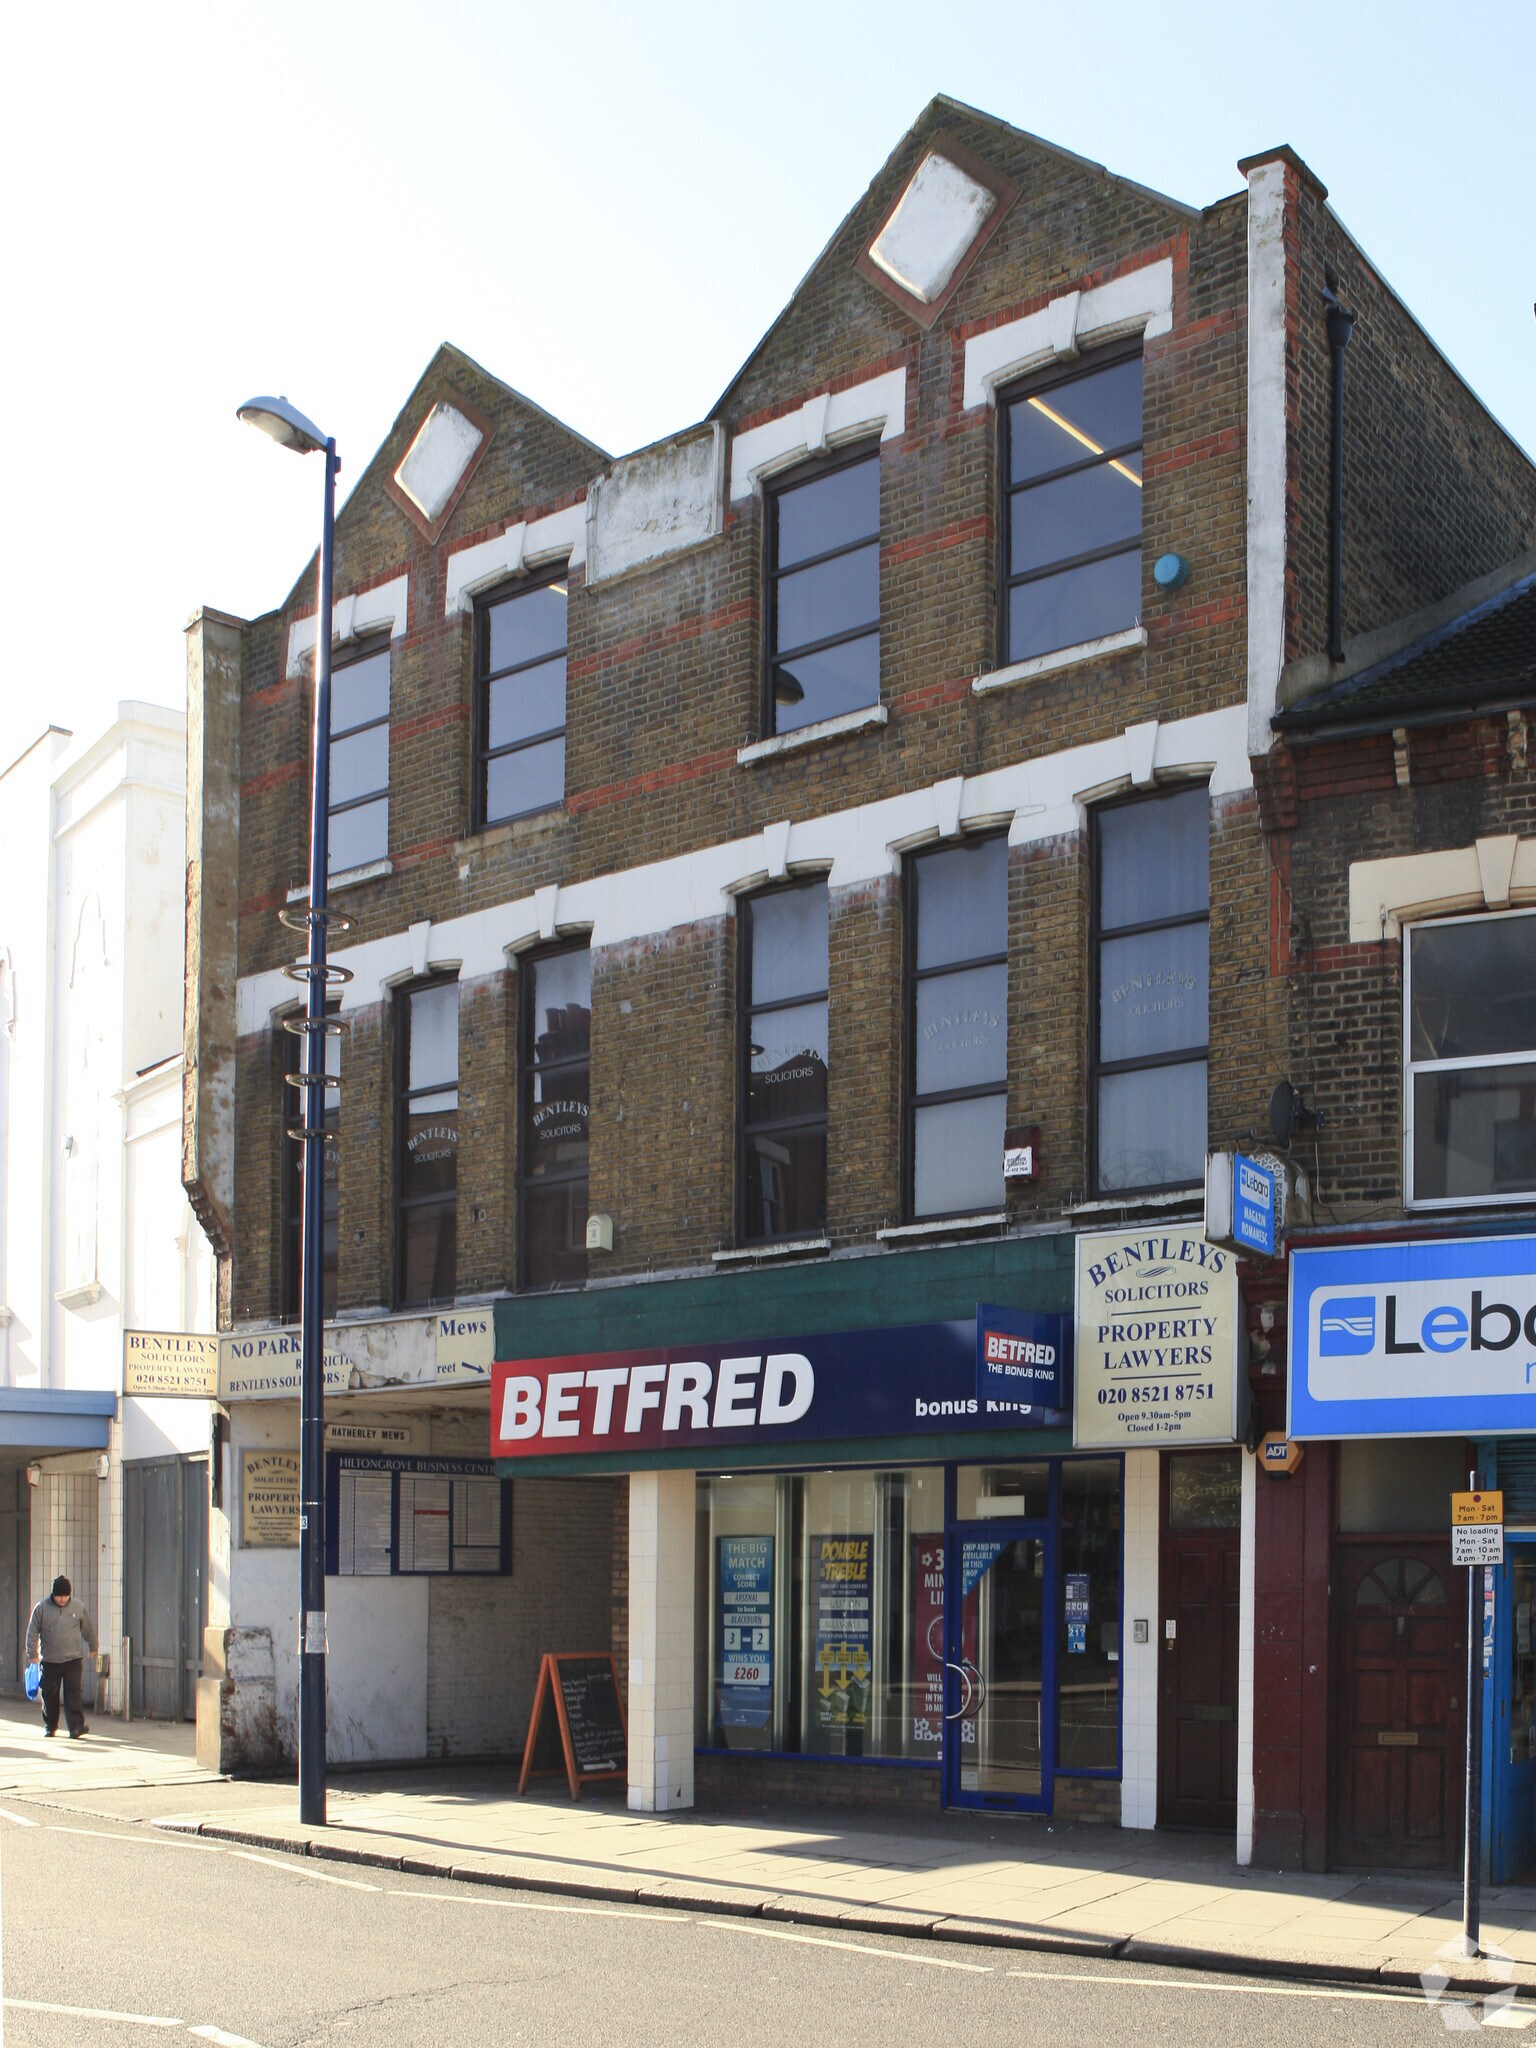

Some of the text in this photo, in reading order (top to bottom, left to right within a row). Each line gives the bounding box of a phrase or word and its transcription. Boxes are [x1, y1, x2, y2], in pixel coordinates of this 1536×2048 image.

[1123, 997, 1184, 1017] SOLICITORS
[765, 1067, 813, 1084] SOLICITORS
[533, 1101, 589, 1126] BENTLEYS
[541, 1124, 581, 1139] SOLICITORS
[408, 1127, 458, 1151] BENTLEYS
[415, 1149, 451, 1163] SOLICITORS
[1244, 1206, 1266, 1228] MAGAZIN
[1242, 1222, 1268, 1245] ROMANESC
[1087, 1238, 1227, 1288] BENTLEYS
[1105, 1281, 1208, 1303] SOLICITORS
[440, 1319, 487, 1337] Mews
[1098, 1317, 1218, 1344] PROPERTY
[130, 1336, 217, 1354] BENTLEYS
[232, 1338, 302, 1359] NO PARK
[988, 1336, 1055, 1366] BETFRED
[141, 1352, 205, 1363] SOLICITORS
[1104, 1345, 1212, 1370] LAWYERS
[128, 1363, 216, 1374] PROPERTY LAWYERS
[988, 1362, 1054, 1380] THE BONUS KING
[136, 1374, 207, 1386] 020 8521 8751
[230, 1378, 277, 1392] BENTLEYS
[500, 1353, 815, 1440] BETFRED
[1098, 1383, 1213, 1404] 020 8521 8751
[915, 1398, 978, 1416] bonus
[1118, 1410, 1191, 1423] Open 9.30am-5pm
[332, 1427, 405, 1440] HATHERLEY MEWS
[1127, 1422, 1181, 1433] Closed 1-2pm
[1266, 1446, 1287, 1456] ADT
[247, 1456, 300, 1474] BENTLEY
[339, 1457, 496, 1474] HILTONGROVE BUSINESS CENTR
[254, 1476, 298, 1484] SOLICITORS
[727, 1543, 767, 1554] THE BIG
[821, 1541, 868, 1560] DOUBLE
[963, 1543, 976, 1551] CHIP
[728, 1557, 765, 1569] MATCH
[963, 1552, 992, 1560] AVAILABLE
[825, 1562, 867, 1581] TREBLE
[963, 1569, 978, 1577] SHOP
[734, 1594, 758, 1602] ARSENAL
[731, 1616, 762, 1624] BLACKBURN
[730, 1632, 735, 1644] 3
[758, 1633, 763, 1645] 2
[728, 1654, 765, 1662] WINS YOU
[734, 1667, 759, 1680] £260
[930, 1684, 937, 1692] BE
[926, 1694, 933, 1702] IN
[925, 1704, 932, 1712] 30
